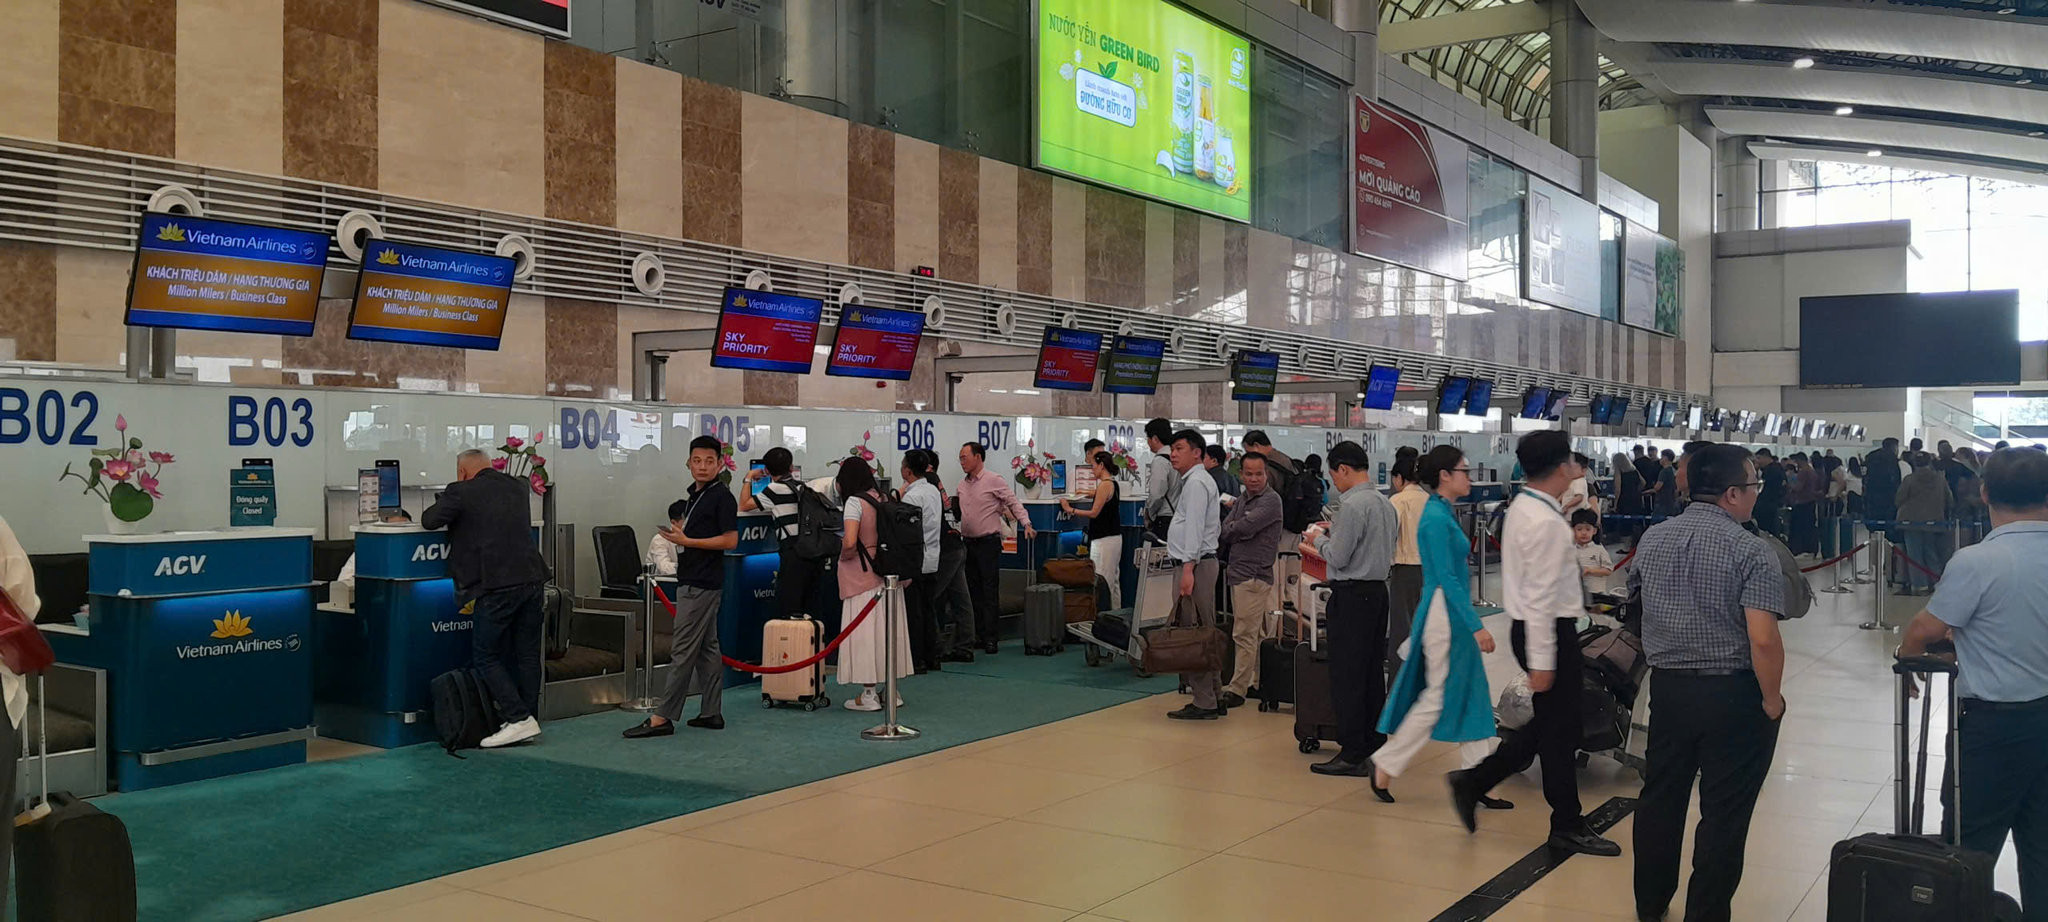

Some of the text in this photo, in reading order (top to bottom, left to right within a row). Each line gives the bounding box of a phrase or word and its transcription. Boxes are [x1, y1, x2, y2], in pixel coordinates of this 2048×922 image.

[1049, 13, 1160, 73] NƯỚC YẾN GREEN BIRD
[1080, 90, 1105, 110] ĐƯỜNG
[1359, 169, 1420, 203] MỜI QUẢNG CÁO
[187, 230, 297, 254] Vietnam Airlines
[401, 254, 489, 276] Vietnam Airlines
[147, 265, 178, 279] KHÁCH
[180, 268, 204, 284] TRIỆU
[258, 275, 295, 290] THƯƠNG
[296, 280, 310, 291] GIA
[168, 284, 197, 297] Million
[199, 287, 224, 300] Milers
[230, 289, 266, 302] Business
[266, 292, 287, 304] Class
[367, 286, 393, 298] KHÁCH
[394, 288, 415, 303] TRIỆU
[457, 296, 486, 308] THƯƠNG
[486, 300, 498, 310] GIA
[383, 303, 410, 314] Million
[408, 306, 428, 317] Milers
[433, 308, 461, 320] Business
[462, 311, 479, 321] Class
[748, 298, 805, 316] Vietnam Airlines
[861, 313, 910, 328] Vietnam Airlines
[724, 332, 746, 342] SKY
[722, 342, 769, 355] PRIORITY
[837, 352, 877, 364] PRIORITY
[840, 344, 857, 353] SKY
[1042, 368, 1069, 377] PRIORITY
[0, 387, 99, 446] B02
[228, 395, 314, 447] B03
[560, 407, 620, 450] B04
[701, 414, 750, 452] B05
[897, 418, 934, 450] B06
[978, 420, 1010, 450] B07
[1363, 432, 1376, 453] B11
[1498, 437, 1509, 454] B14
[742, 526, 768, 541] ACV
[411, 544, 451, 562] ACV
[154, 554, 206, 577] ACV
[177, 637, 283, 660] Vietnam Airlines
